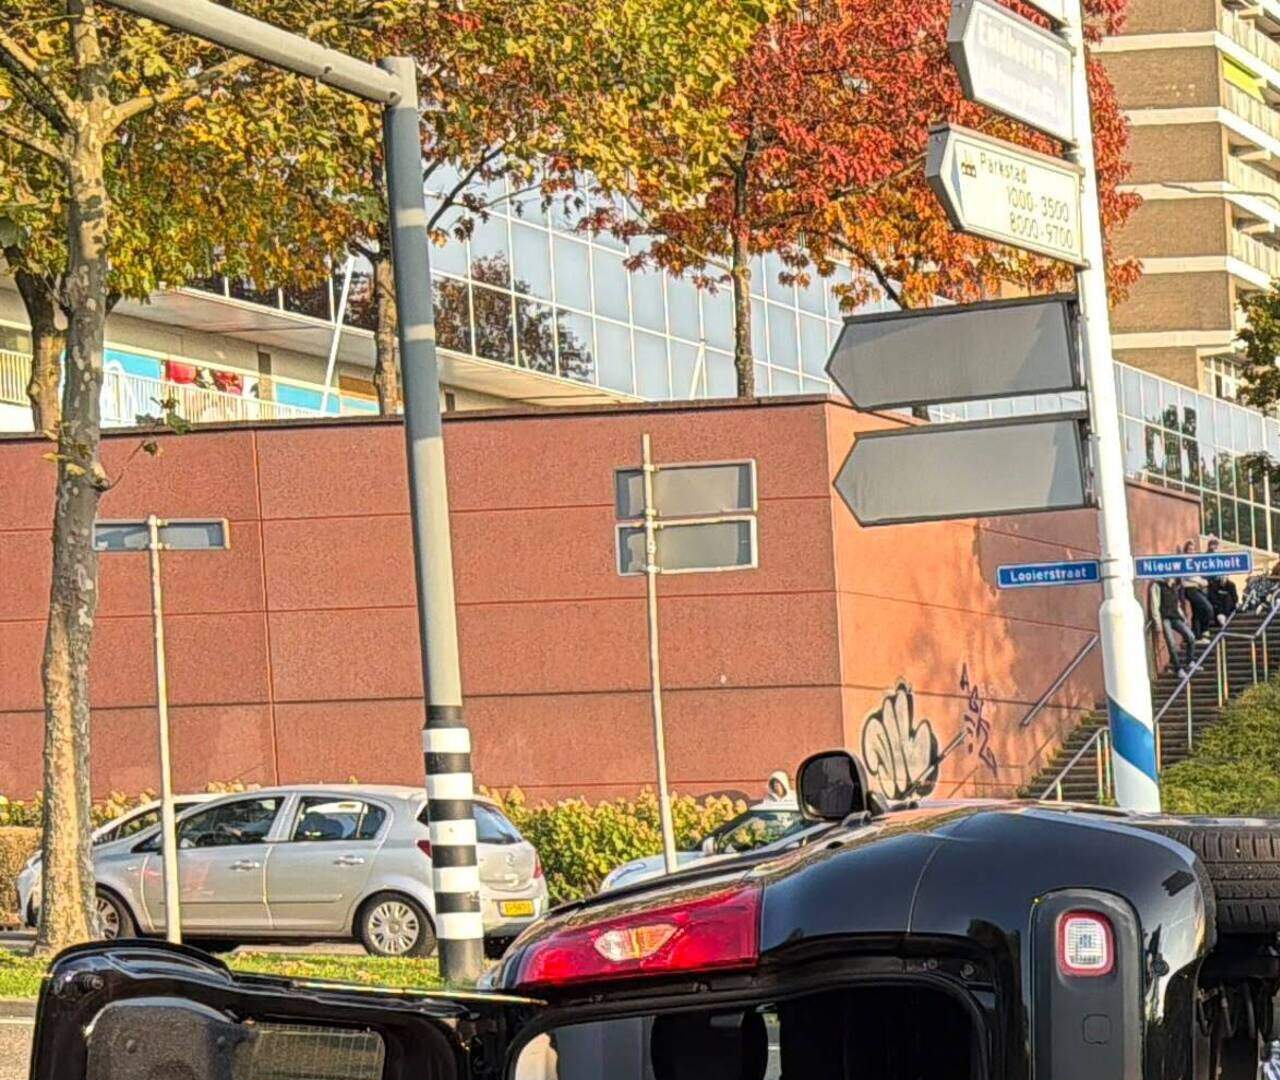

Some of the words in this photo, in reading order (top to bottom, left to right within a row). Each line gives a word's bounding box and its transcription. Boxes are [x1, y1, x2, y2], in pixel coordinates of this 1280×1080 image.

[1143, 559, 1182, 571] Nieuw
[1186, 556, 1241, 571] Eyckholt
[1010, 569, 1087, 582] Looierstraat
